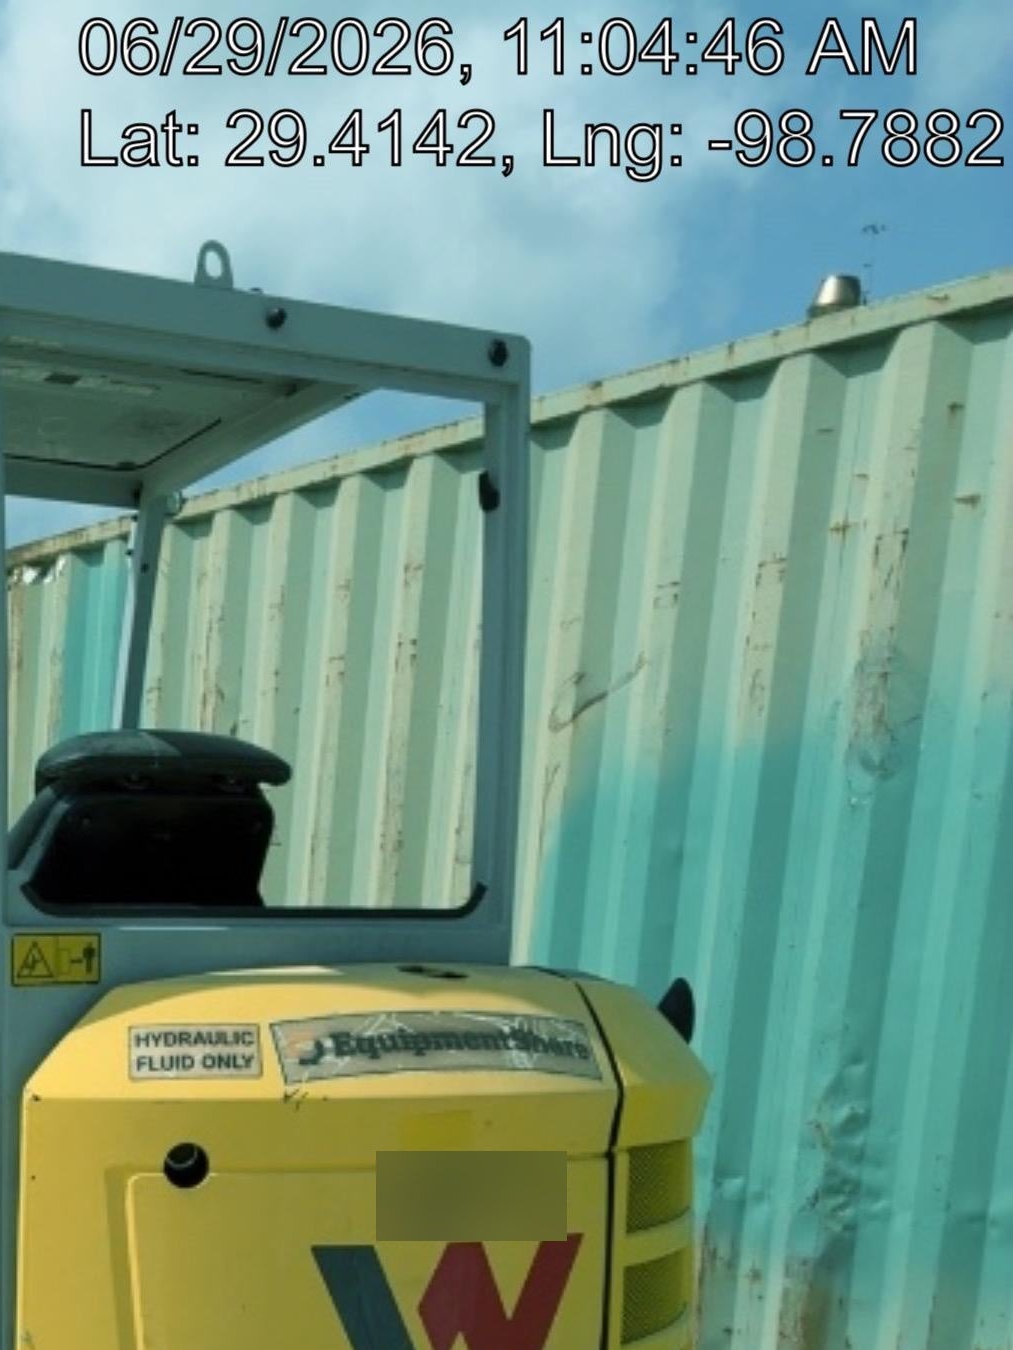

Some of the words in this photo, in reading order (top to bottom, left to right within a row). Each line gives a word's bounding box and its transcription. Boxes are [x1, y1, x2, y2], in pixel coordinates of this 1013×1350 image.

[134, 1031, 254, 1047] HYDRAULIC
[135, 1055, 195, 1072] FLUID
[201, 1053, 255, 1071] ONLY
